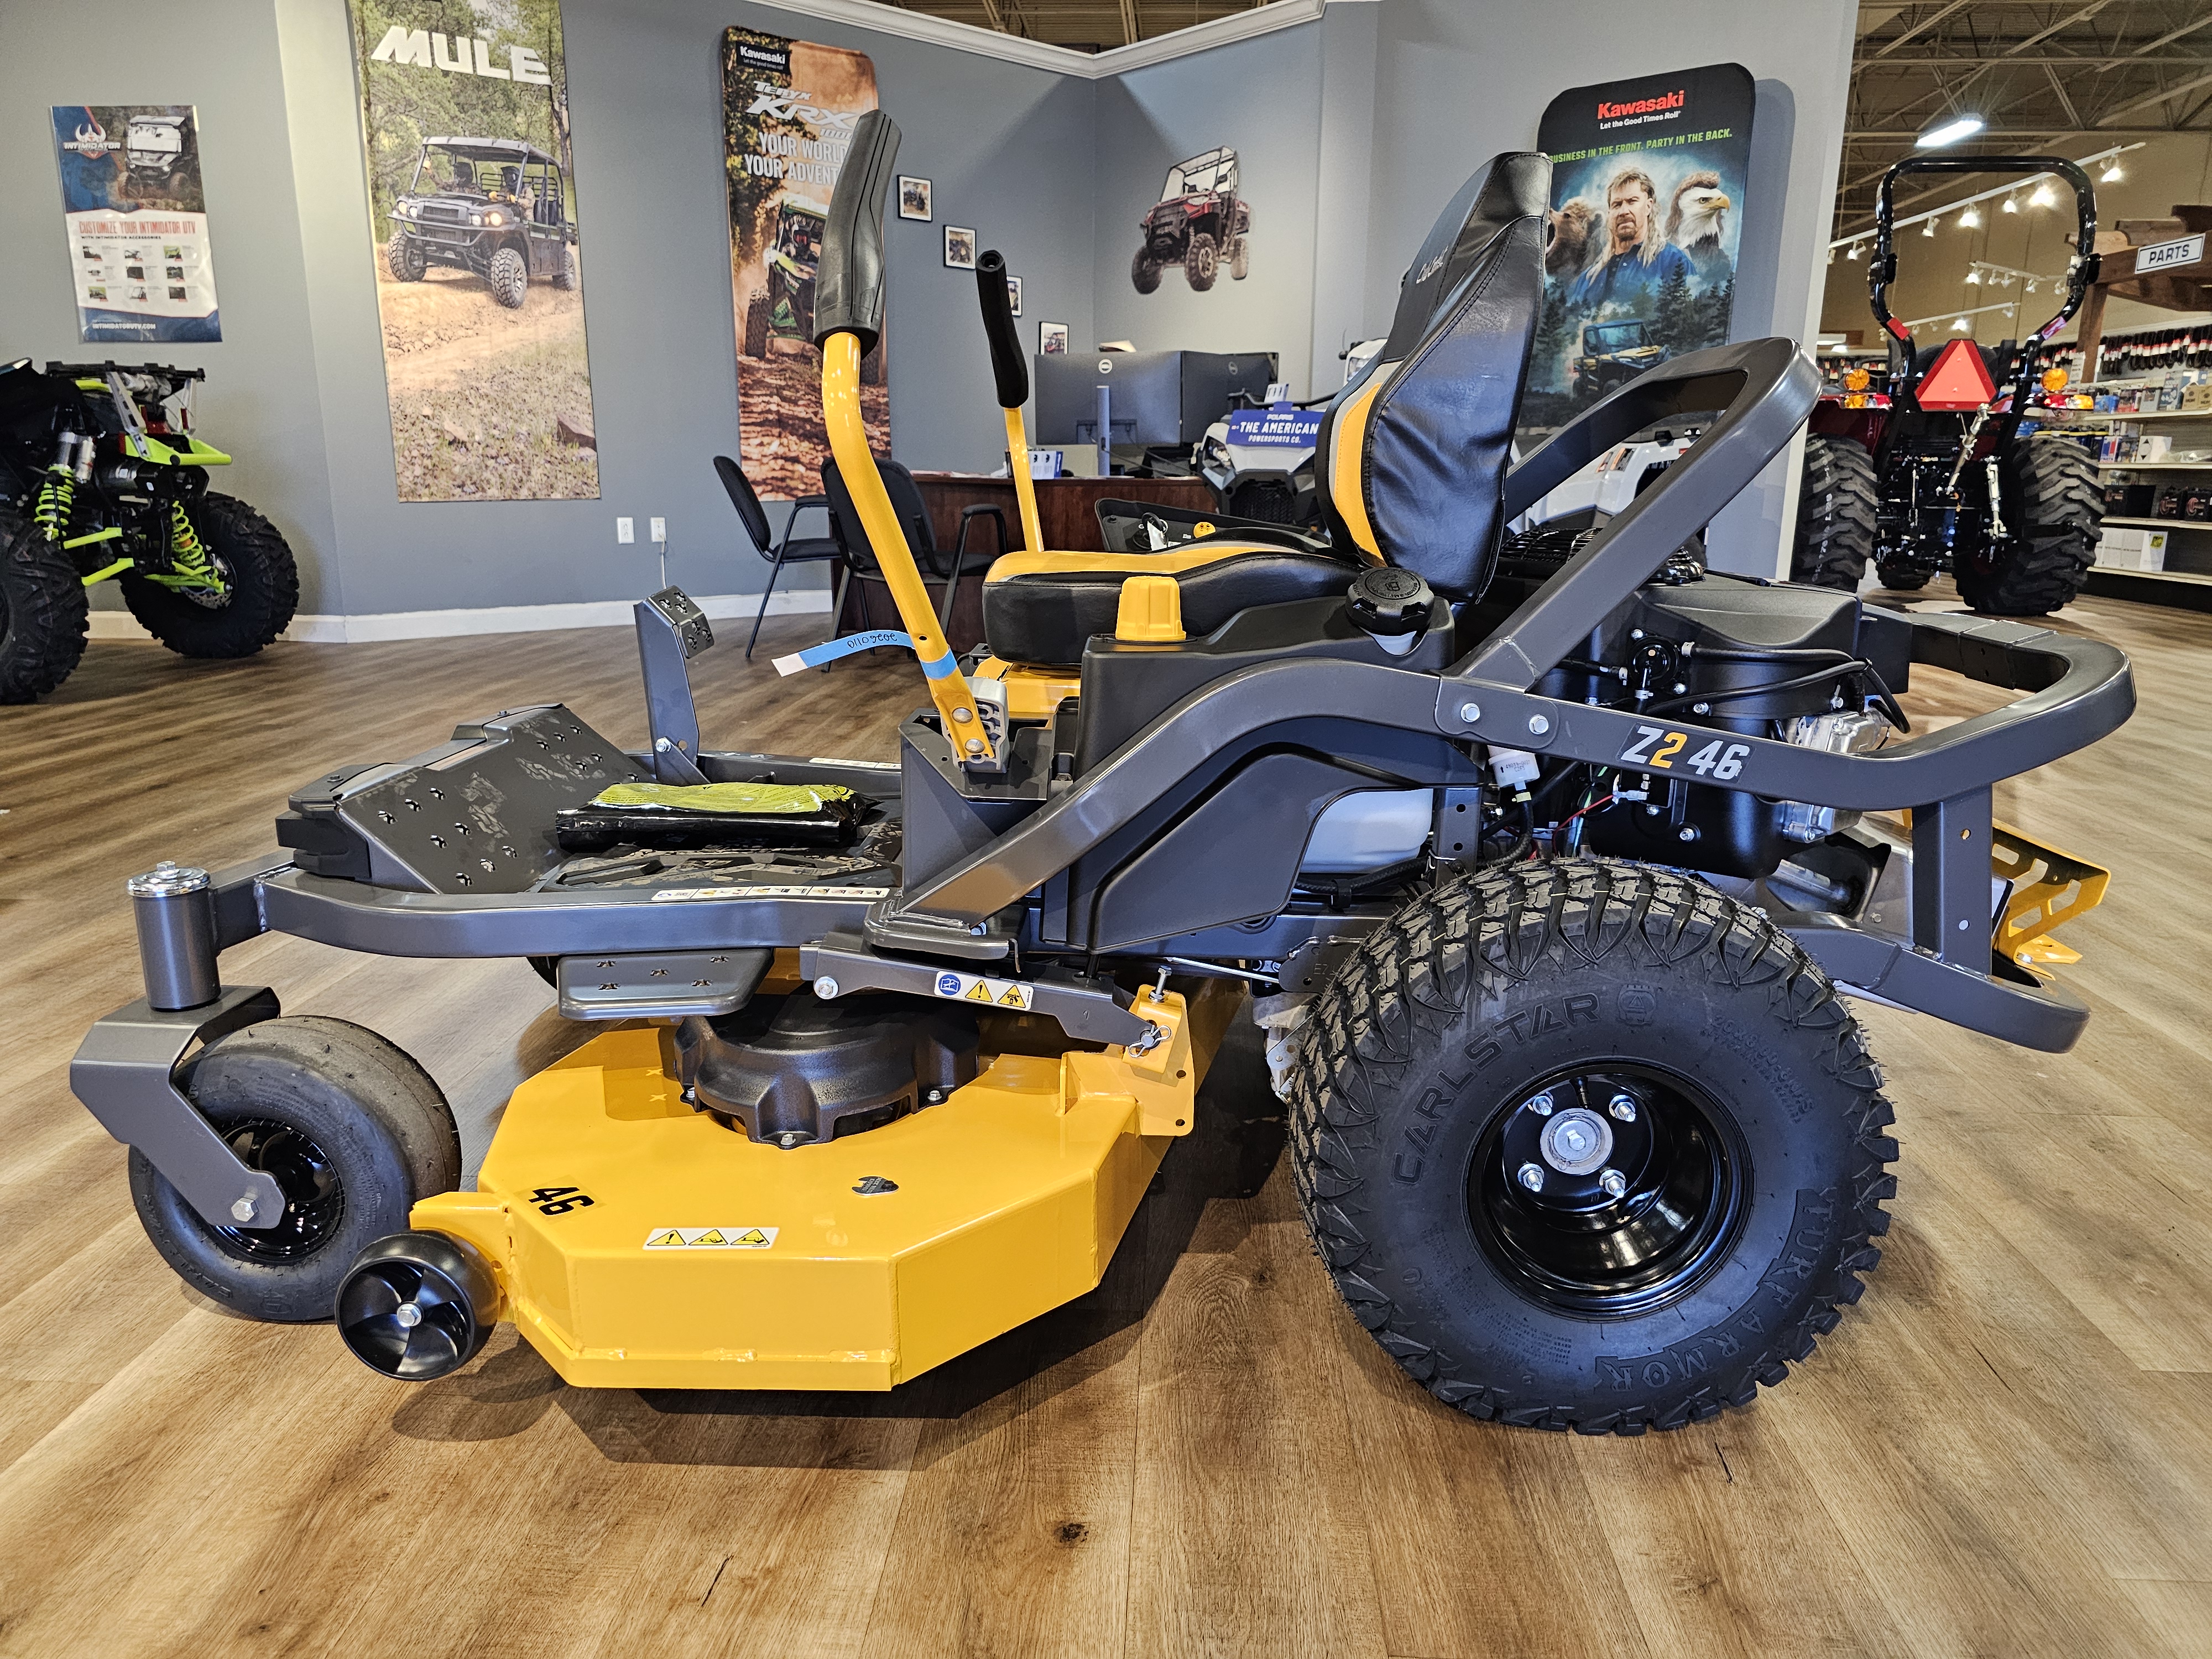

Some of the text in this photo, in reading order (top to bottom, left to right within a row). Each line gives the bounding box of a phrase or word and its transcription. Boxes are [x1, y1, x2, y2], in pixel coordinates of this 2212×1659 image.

[371, 25, 552, 86] MULE
[740, 46, 785, 64] Kawasaki
[746, 93, 857, 130] KRX
[1597, 90, 1684, 119] Kawasaki
[1600, 122, 1611, 130] Let
[1624, 117, 1642, 126] Good
[1643, 114, 1664, 123] Times
[758, 132, 798, 157] YOUR
[1588, 148, 1597, 158] IN
[1598, 146, 1614, 156] THE
[1615, 141, 1644, 154] FRONT.
[1646, 137, 1674, 149] PARTY
[1675, 135, 1685, 145] IN
[1687, 132, 1704, 143] THE
[1705, 128, 1733, 140] BACK.
[744, 153, 784, 179] YOUR
[79, 221, 195, 234] CUSTOMIZE YOUR INTIMIDATOR UTV
[2148, 244, 2189, 264] PARTS
[1240, 422, 1319, 434] THE AMERICAN
[1248, 435, 1290, 443] POWERSPORTS
[1687, 739, 1750, 780] 46
[1392, 991, 1601, 1185] CARLSTAR
[528, 1187, 595, 1215] 46
[1609, 1191, 1835, 1391] TURF ARMOR
